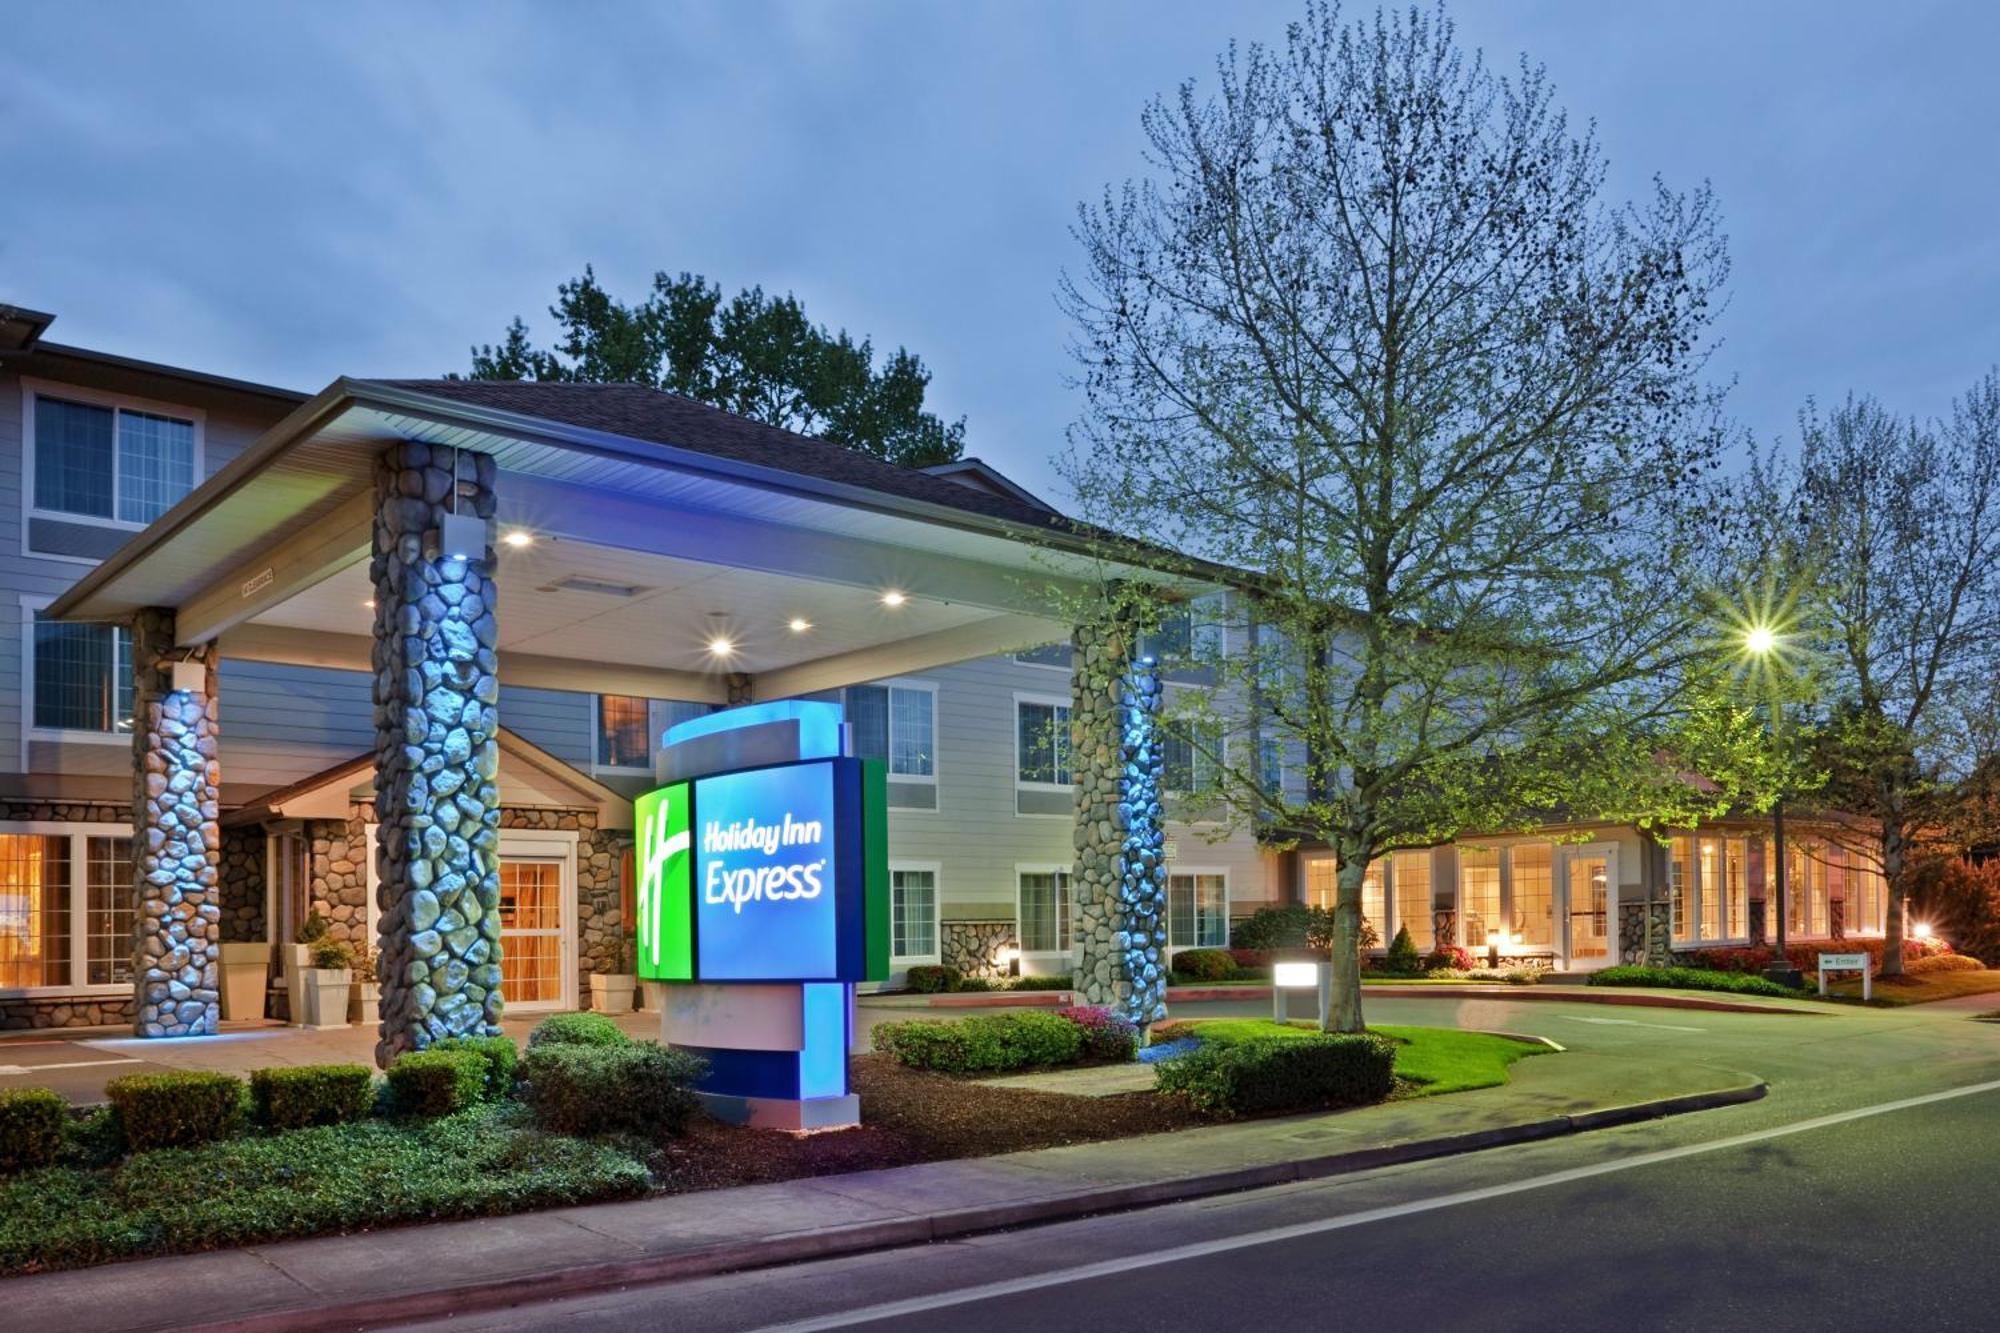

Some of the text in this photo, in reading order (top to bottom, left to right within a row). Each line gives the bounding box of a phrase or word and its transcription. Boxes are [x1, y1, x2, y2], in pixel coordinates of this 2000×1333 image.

[704, 813, 821, 855] Holiday Inn
[705, 860, 823, 914] Express
